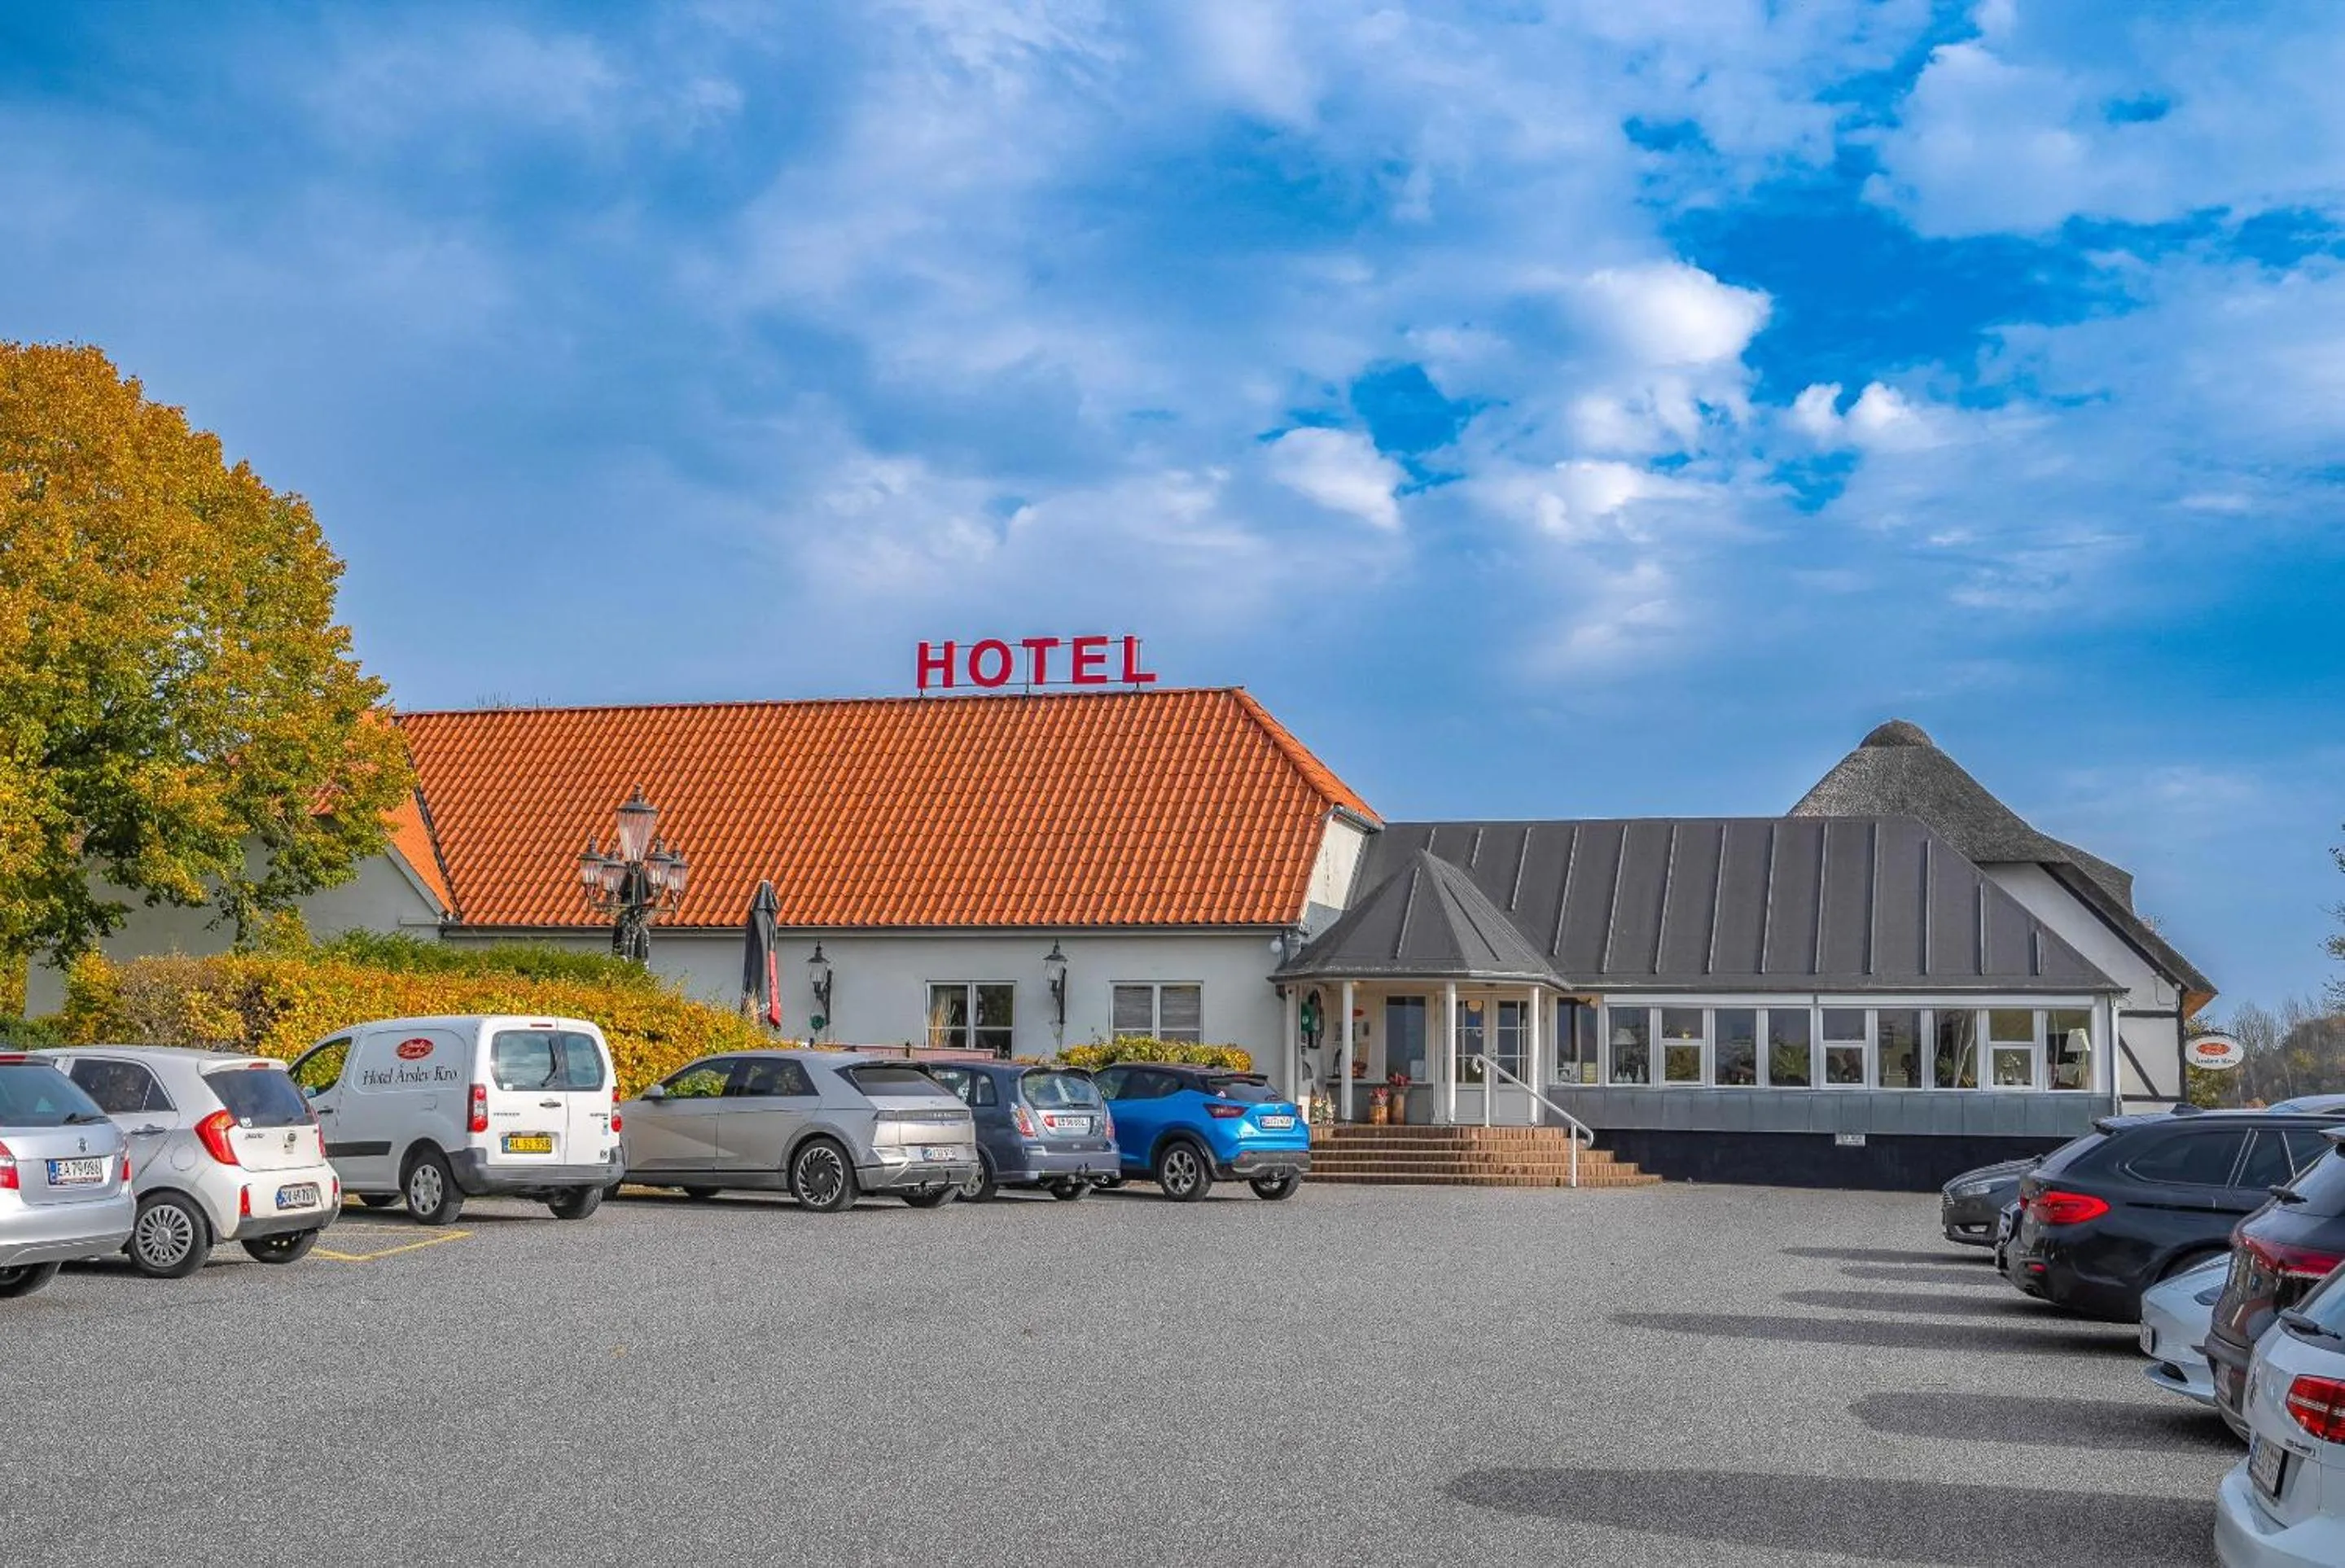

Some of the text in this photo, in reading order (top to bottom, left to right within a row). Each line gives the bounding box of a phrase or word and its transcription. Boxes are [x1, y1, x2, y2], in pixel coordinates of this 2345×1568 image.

[917, 635, 1157, 689] HOTEL
[362, 1062, 458, 1085] Hotel Årslev Kro
